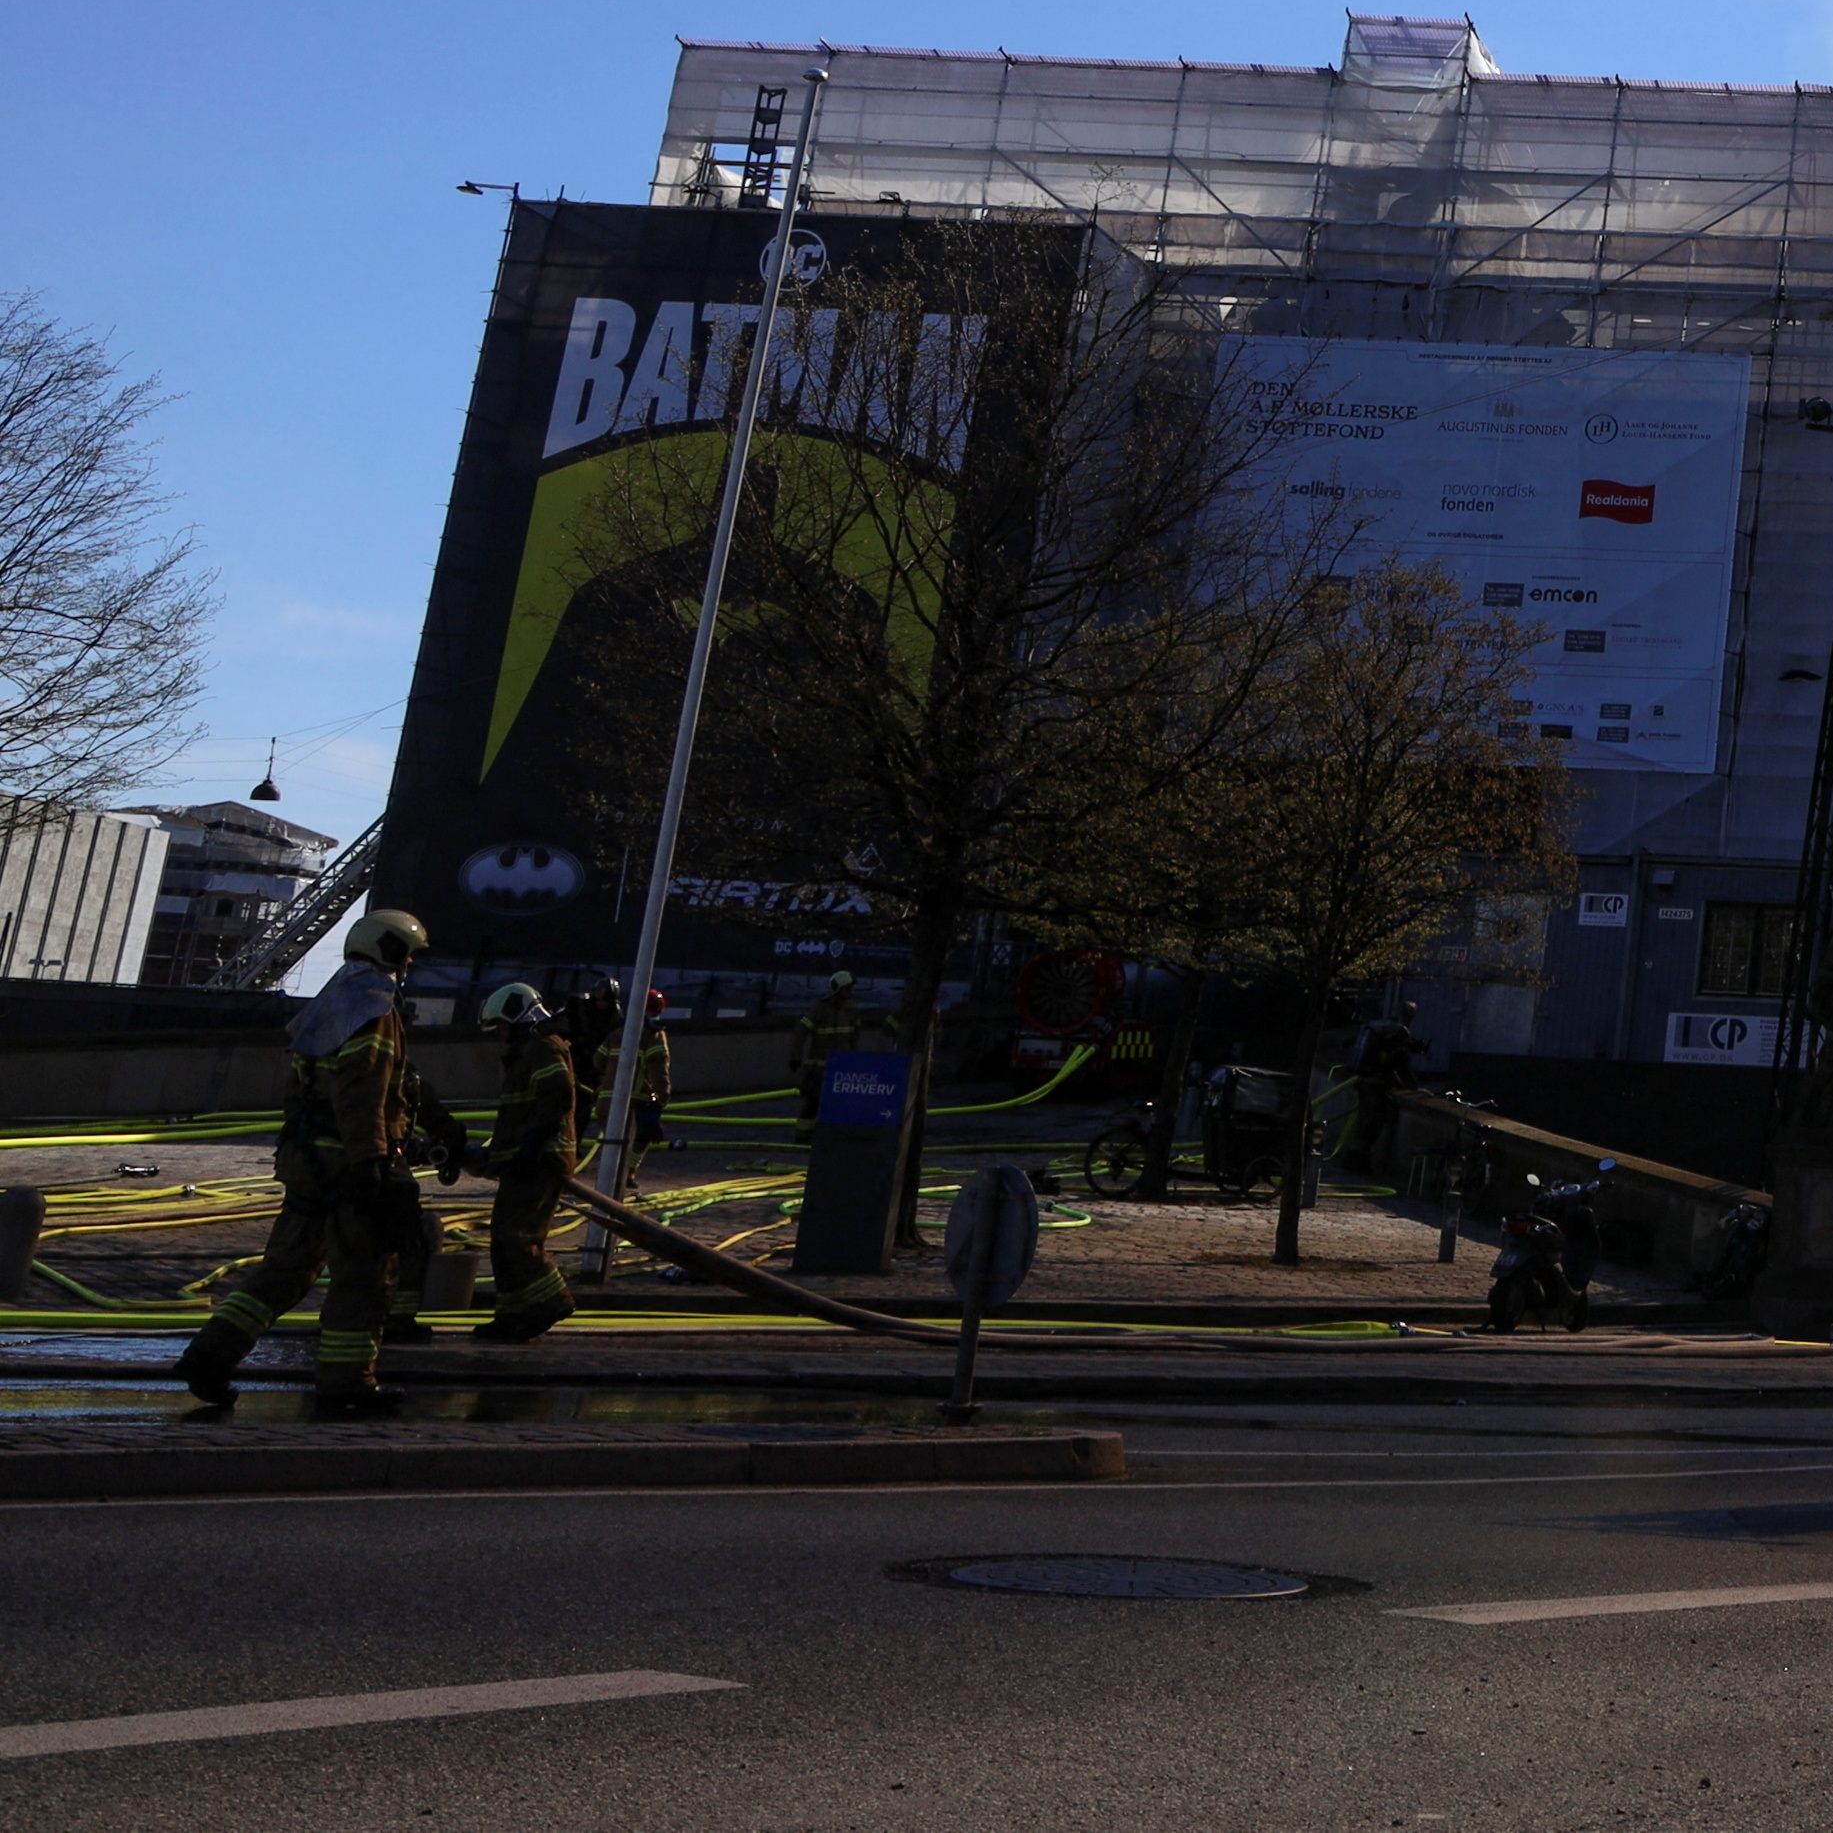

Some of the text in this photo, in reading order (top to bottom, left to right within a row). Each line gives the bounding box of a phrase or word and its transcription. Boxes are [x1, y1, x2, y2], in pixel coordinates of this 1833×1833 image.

[541, 296, 989, 472] BATMAN
[1252, 381, 1294, 396] DEN
[1291, 401, 1418, 419] MØLLERSKE
[1246, 420, 1385, 439] STØTTEFOND
[1437, 421, 1568, 436] AUGUSTINUS FONDEN
[1290, 480, 1401, 500] salling fondene
[1442, 483, 1536, 499] novo nordisk
[1440, 496, 1494, 512] fonden
[1585, 493, 1649, 507] Realdania
[1528, 588, 1598, 603] emcon
[834, 1071, 879, 1083] DANSK
[832, 1082, 896, 1095] ERHVERV
